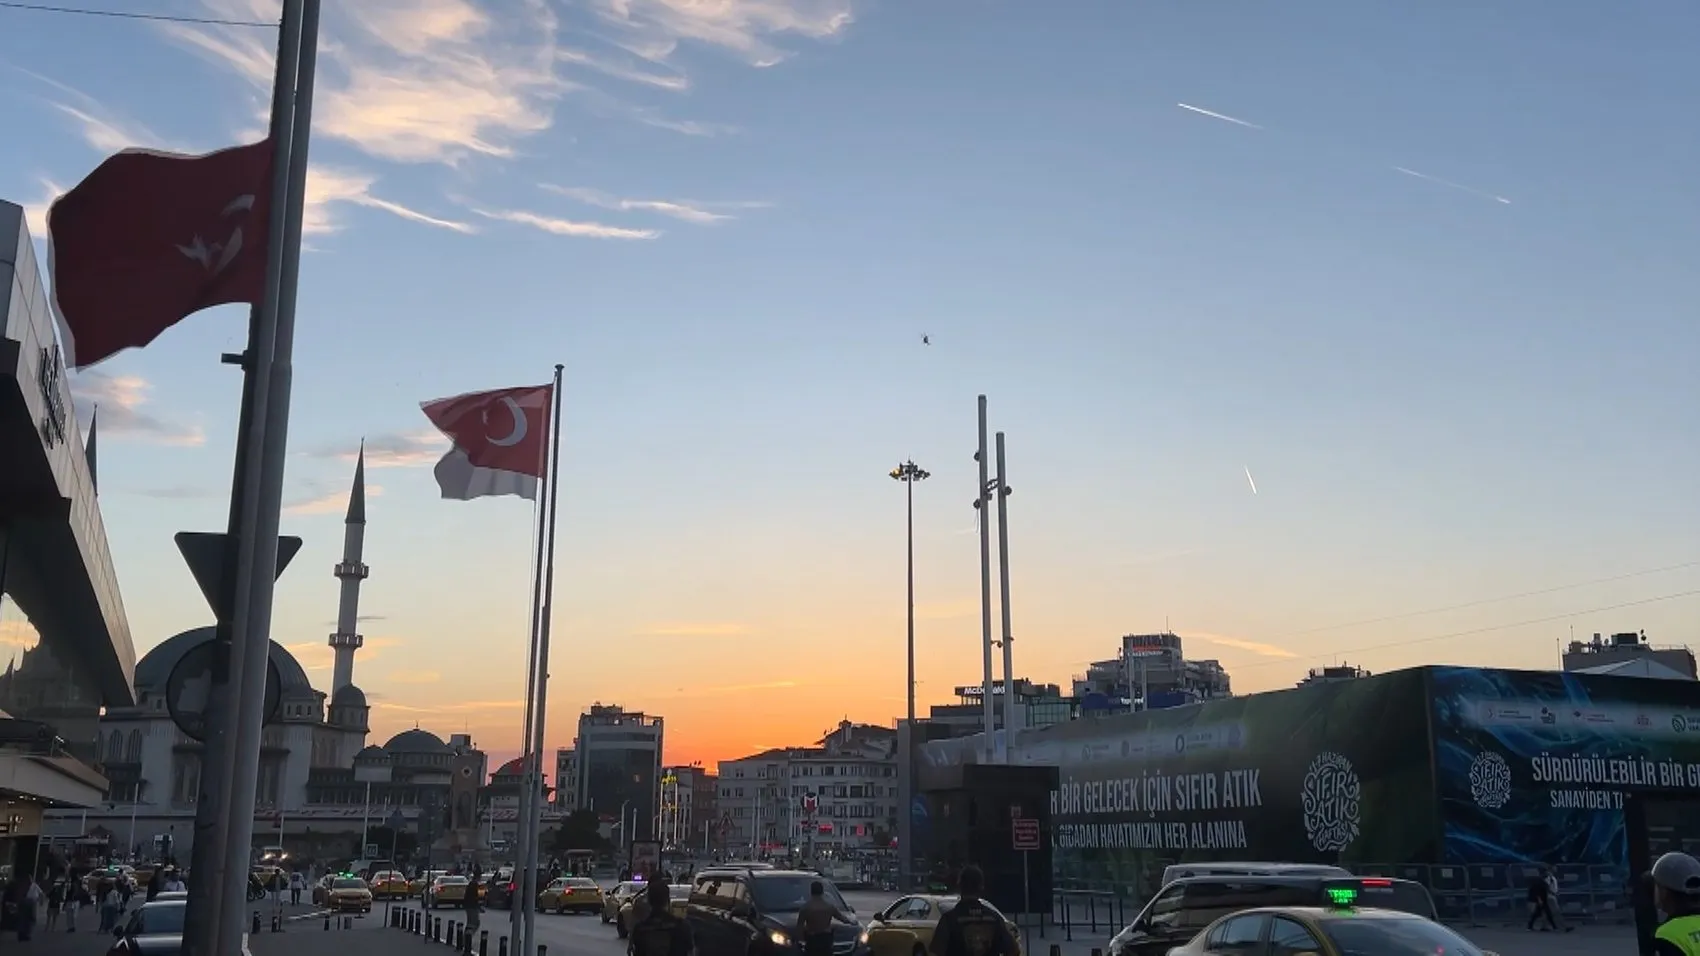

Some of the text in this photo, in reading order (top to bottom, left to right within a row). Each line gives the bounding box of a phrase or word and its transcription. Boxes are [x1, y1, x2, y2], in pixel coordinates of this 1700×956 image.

[1532, 752, 1657, 786] SÜRDÜRÜLEBİLİR
[1660, 757, 1685, 787] BİR
[1061, 776, 1081, 815] BİR
[1084, 776, 1139, 813] GELECEK
[1142, 769, 1173, 818] İÇİN
[1175, 773, 1218, 811] SIFIR
[1222, 768, 1262, 807] ATIK
[1303, 770, 1355, 814] SIFIR
[1550, 786, 1611, 810] SANAYİDEN
[1310, 796, 1358, 830] ATIK
[1059, 825, 1098, 850] GIDADAN
[1100, 822, 1162, 849] HAYATIMIZIN
[1165, 822, 1187, 848] HER
[1191, 820, 1247, 848] ALANINA
